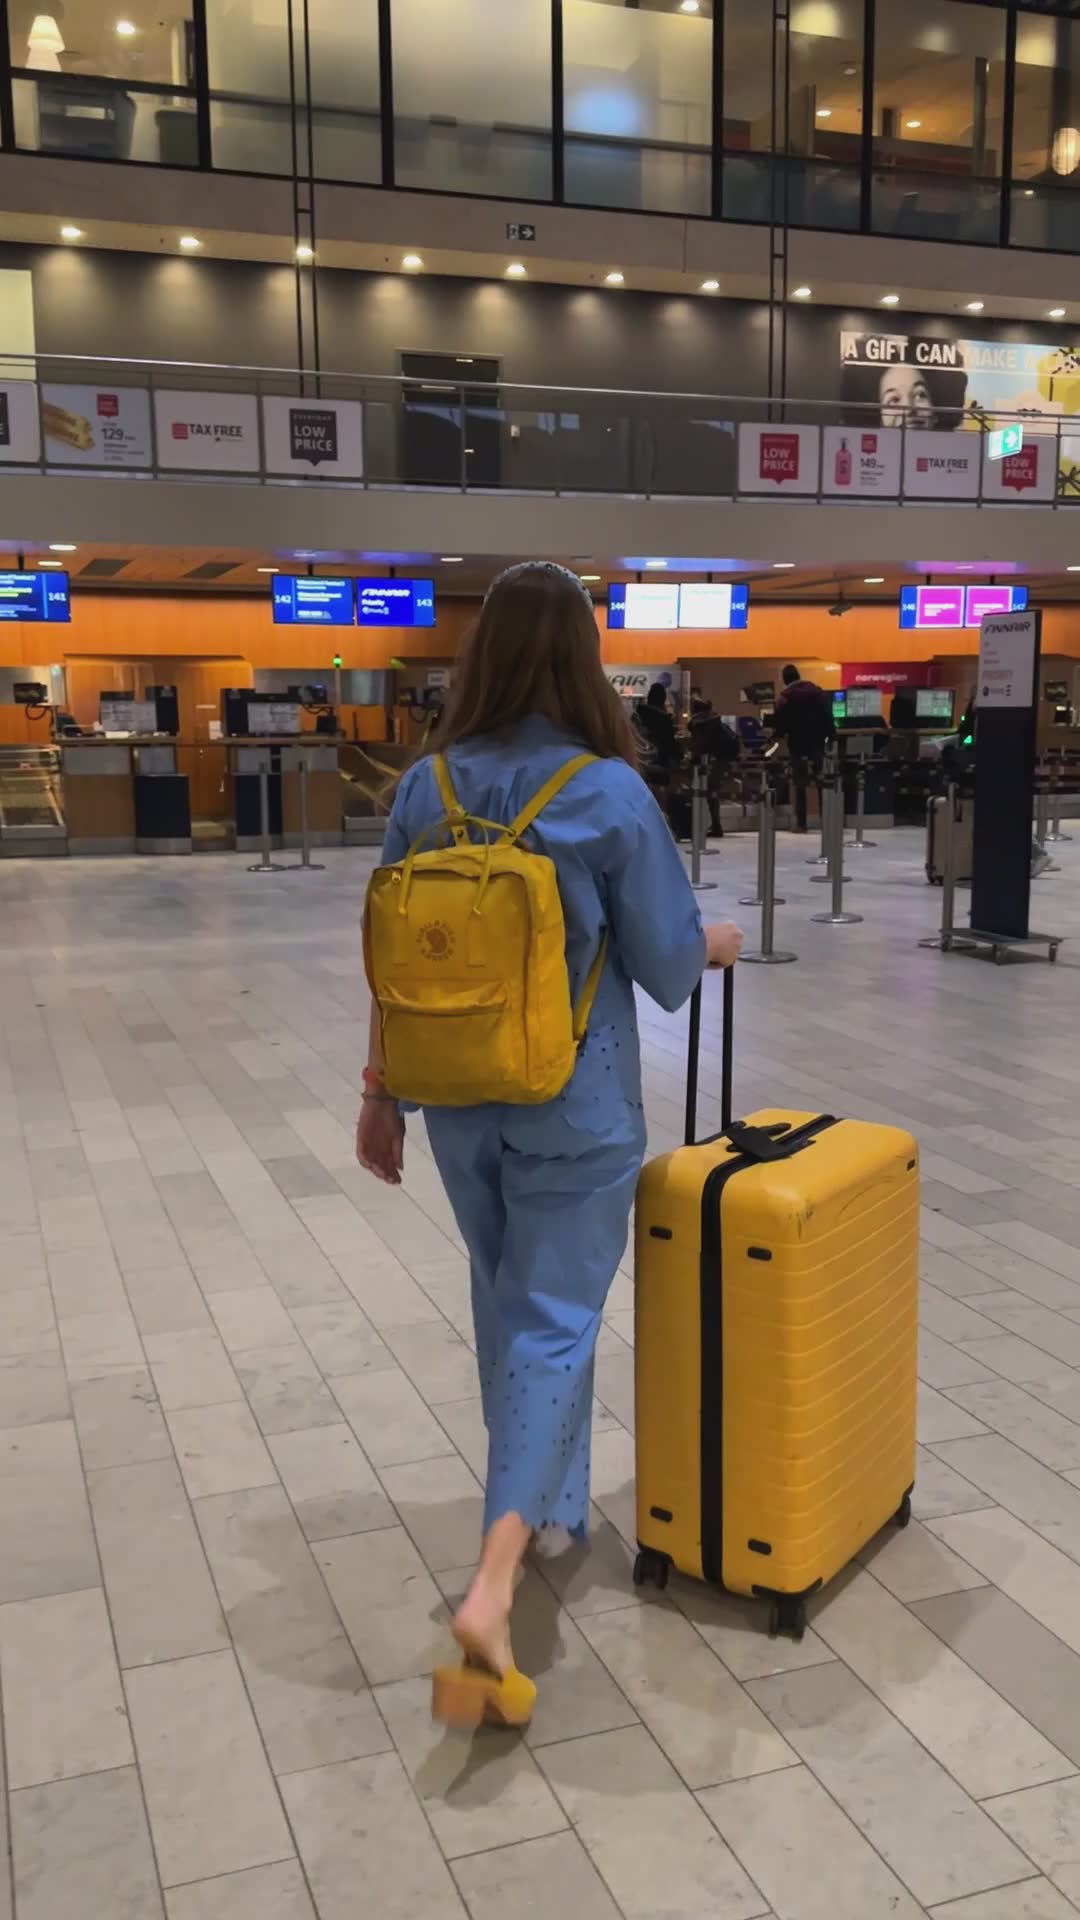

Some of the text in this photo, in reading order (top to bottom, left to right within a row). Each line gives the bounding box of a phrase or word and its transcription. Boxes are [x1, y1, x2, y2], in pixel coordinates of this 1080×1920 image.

[844, 338, 858, 358] A
[865, 339, 908, 361] GIFT
[916, 343, 956, 364] CAN
[101, 428, 123, 440] 129
[190, 423, 212, 436] TAX
[214, 424, 243, 438] FREE
[294, 425, 326, 437] LOW
[295, 438, 333, 451] PRICE
[763, 448, 791, 458] LOW
[763, 459, 795, 471] PRICE
[929, 458, 946, 468] TAX
[947, 459, 968, 469] FREE
[1005, 457, 1030, 467] LOW
[1005, 469, 1034, 480] PRICE
[274, 594, 292, 603] 142
[416, 599, 433, 607] 143
[984, 621, 1031, 634] FINNAIR
[608, 674, 648, 687] AIR
[855, 673, 908, 683] norwegian
